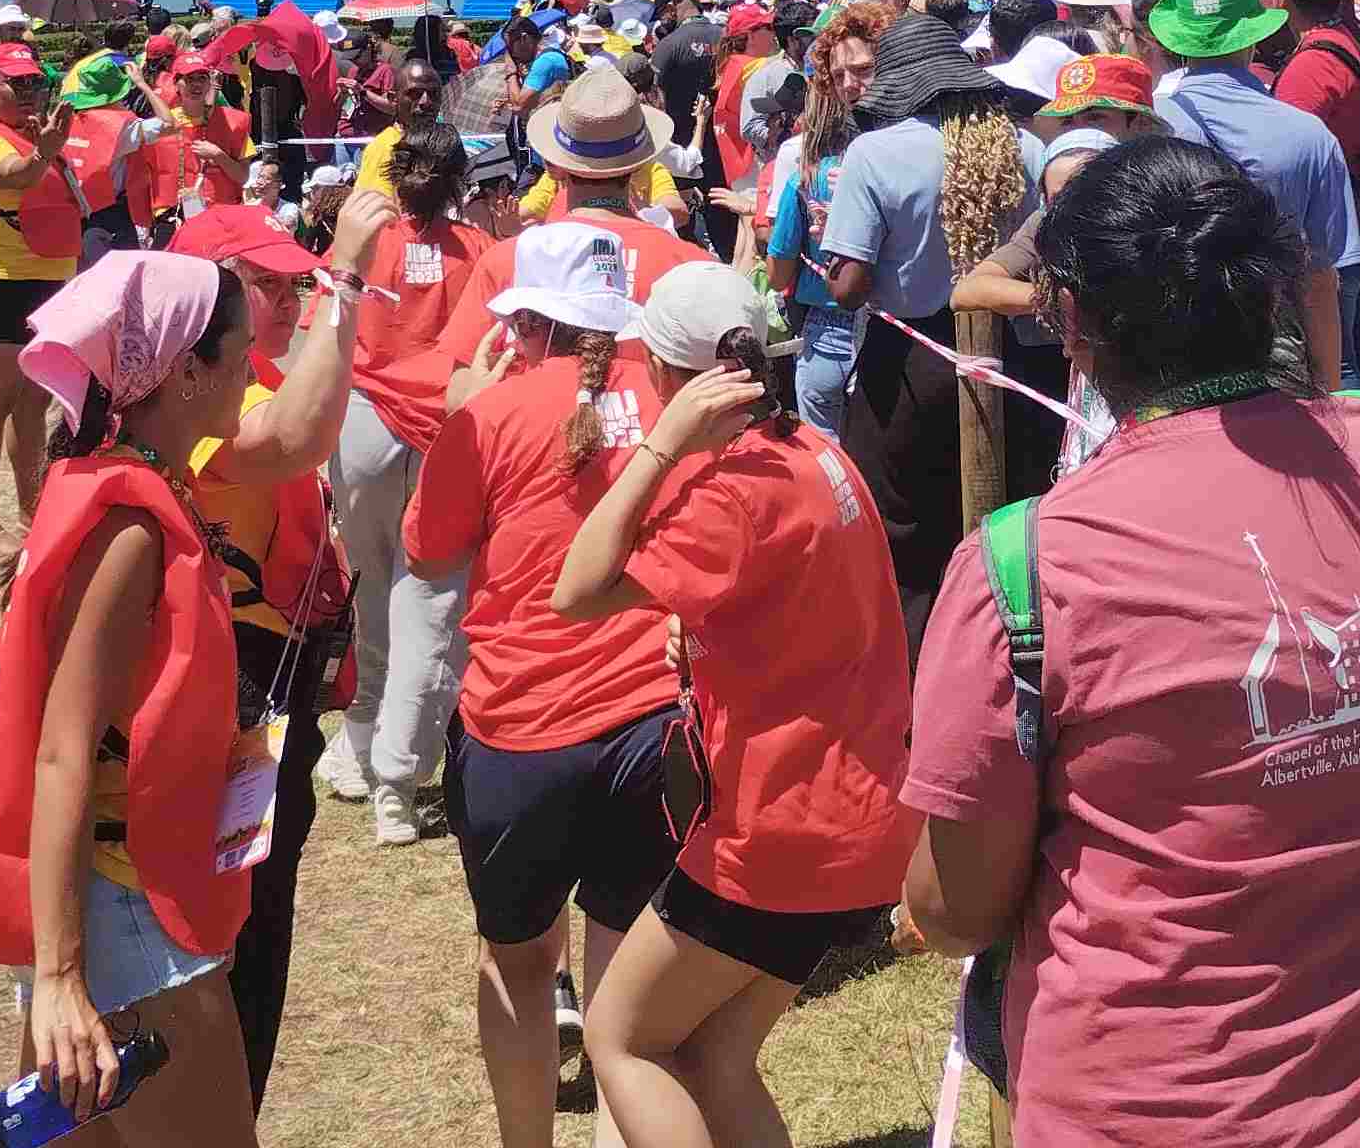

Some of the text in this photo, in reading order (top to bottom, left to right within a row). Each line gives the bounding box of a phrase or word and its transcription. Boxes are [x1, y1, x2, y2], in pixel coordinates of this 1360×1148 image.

[1264, 743, 1312, 767] Chapel
[1314, 738, 1328, 756] of
[1331, 734, 1352, 751] the
